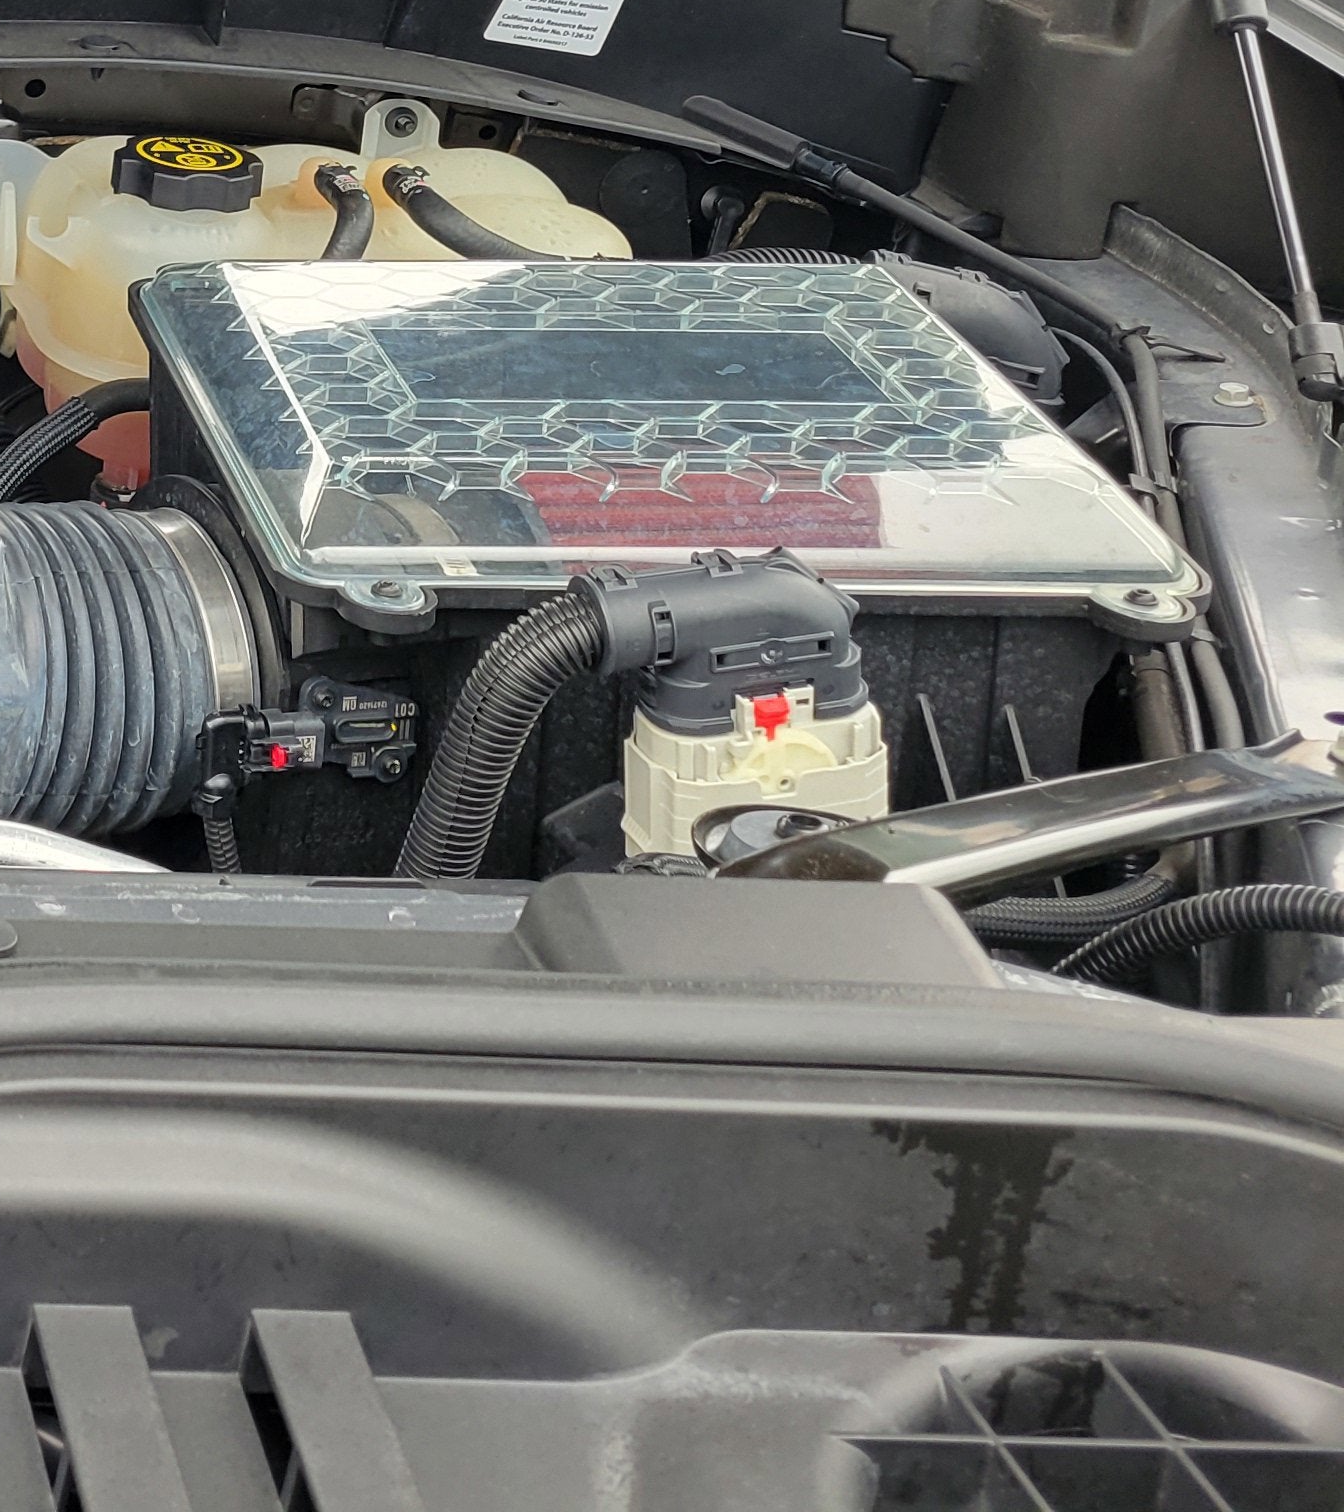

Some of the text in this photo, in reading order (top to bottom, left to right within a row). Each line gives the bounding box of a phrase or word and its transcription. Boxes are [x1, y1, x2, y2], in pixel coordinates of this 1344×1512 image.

[525, 4, 587, 17] controlled vehicles
[579, 2, 609, 10] emission
[497, 21, 529, 31] Executive
[530, 25, 550, 33] Order
[550, 28, 561, 36] No.
[502, 13, 534, 23] California
[577, 24, 599, 32] Board
[341, 696, 357, 711] GM
